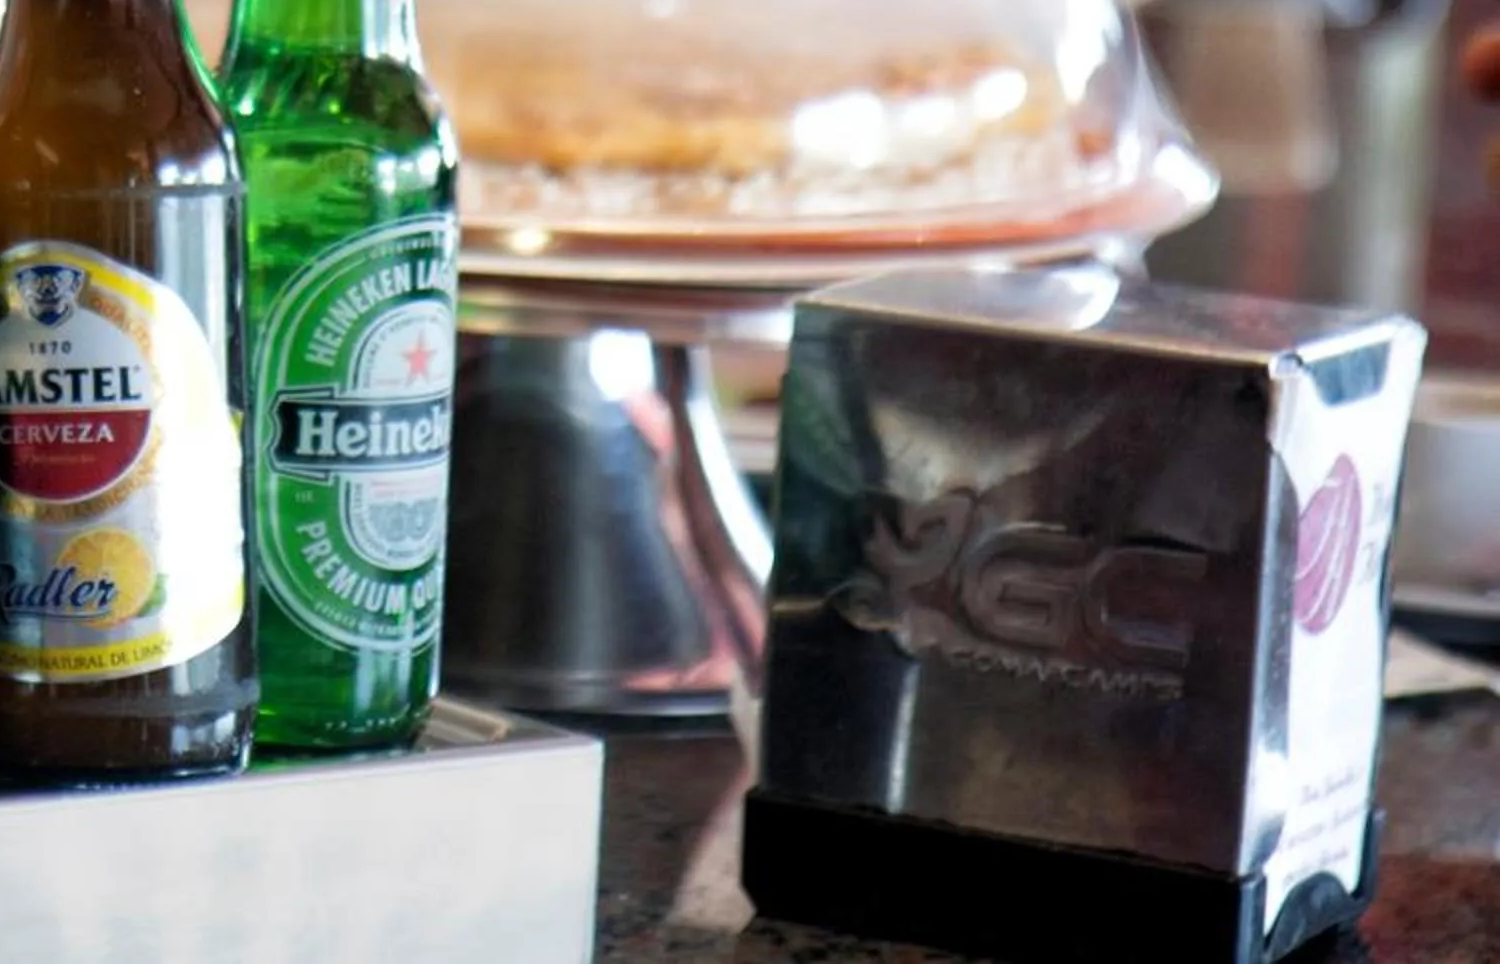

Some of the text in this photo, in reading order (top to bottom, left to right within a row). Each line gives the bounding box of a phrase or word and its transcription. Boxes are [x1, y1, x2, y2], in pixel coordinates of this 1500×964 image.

[29, 340, 72, 355] 1870
[304, 261, 412, 368] HEINEKEN
[295, 520, 407, 616] PREMIUM
